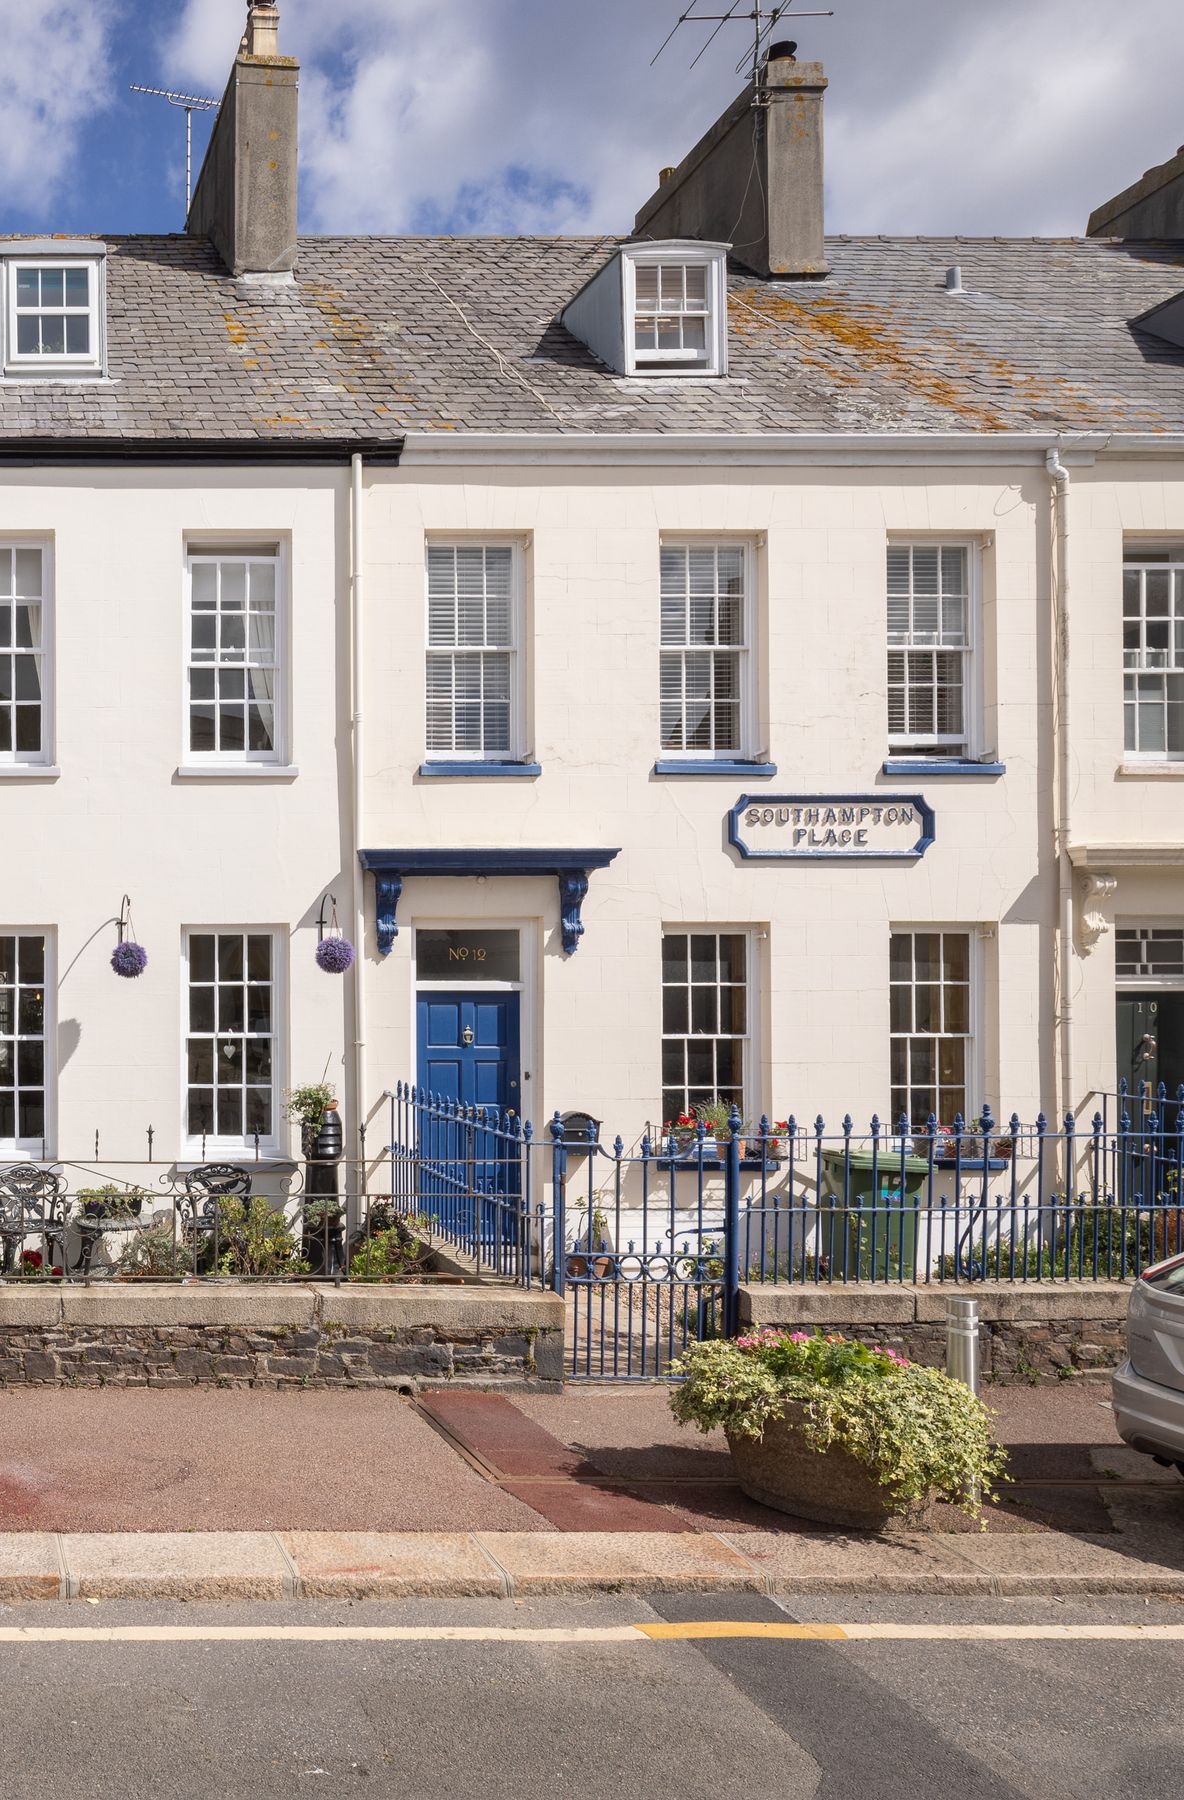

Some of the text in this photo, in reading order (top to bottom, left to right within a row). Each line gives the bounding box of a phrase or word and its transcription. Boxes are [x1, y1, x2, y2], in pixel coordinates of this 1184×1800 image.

[748, 807, 913, 823] SOUTHAMPTON
[796, 828, 868, 844] PLACE
[472, 948, 487, 961] 12
[1137, 1002, 1158, 1013] 10
